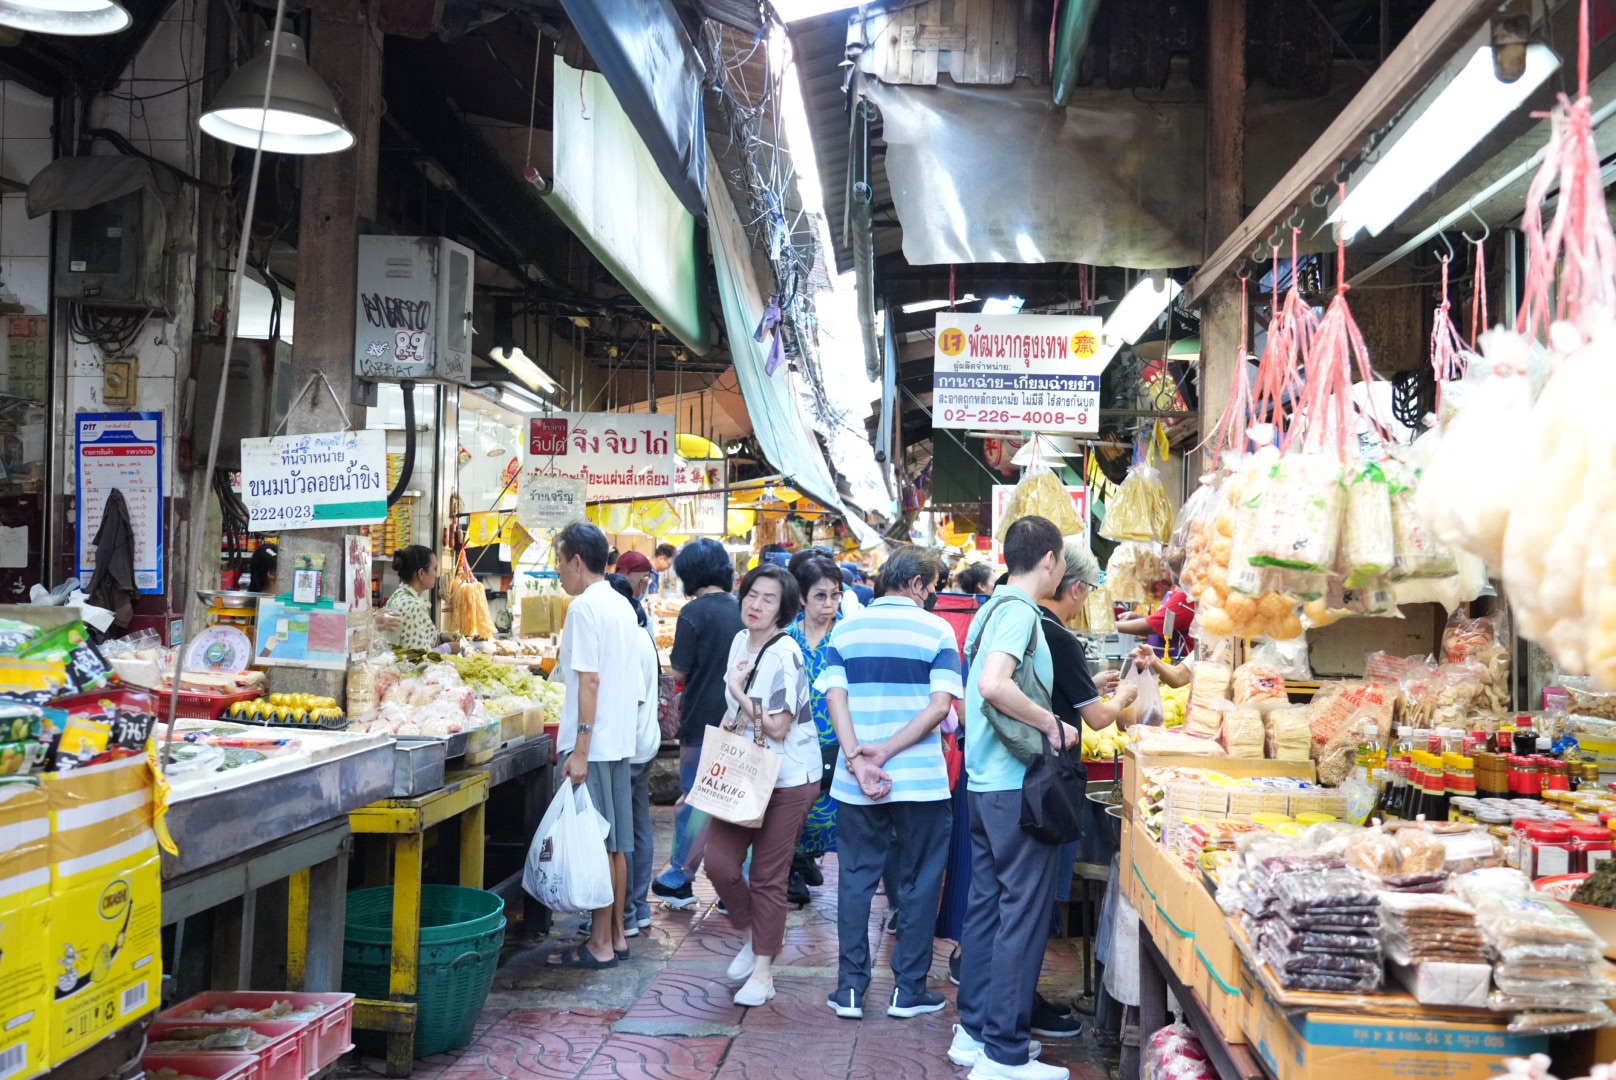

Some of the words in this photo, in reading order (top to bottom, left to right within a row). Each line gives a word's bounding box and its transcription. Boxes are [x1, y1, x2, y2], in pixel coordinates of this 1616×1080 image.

[968, 324, 1069, 368] พัฒนากรุงเทพ
[944, 409, 1087, 425] 02-226-4008-9
[572, 428, 599, 454] จึง
[604, 428, 636, 454] จิบ
[281, 443, 345, 466] ที่นี่จำหน่าย
[249, 460, 380, 497] ขนมบัวลอยน้ำขิง
[529, 489, 573, 504] ร้านเจริญ
